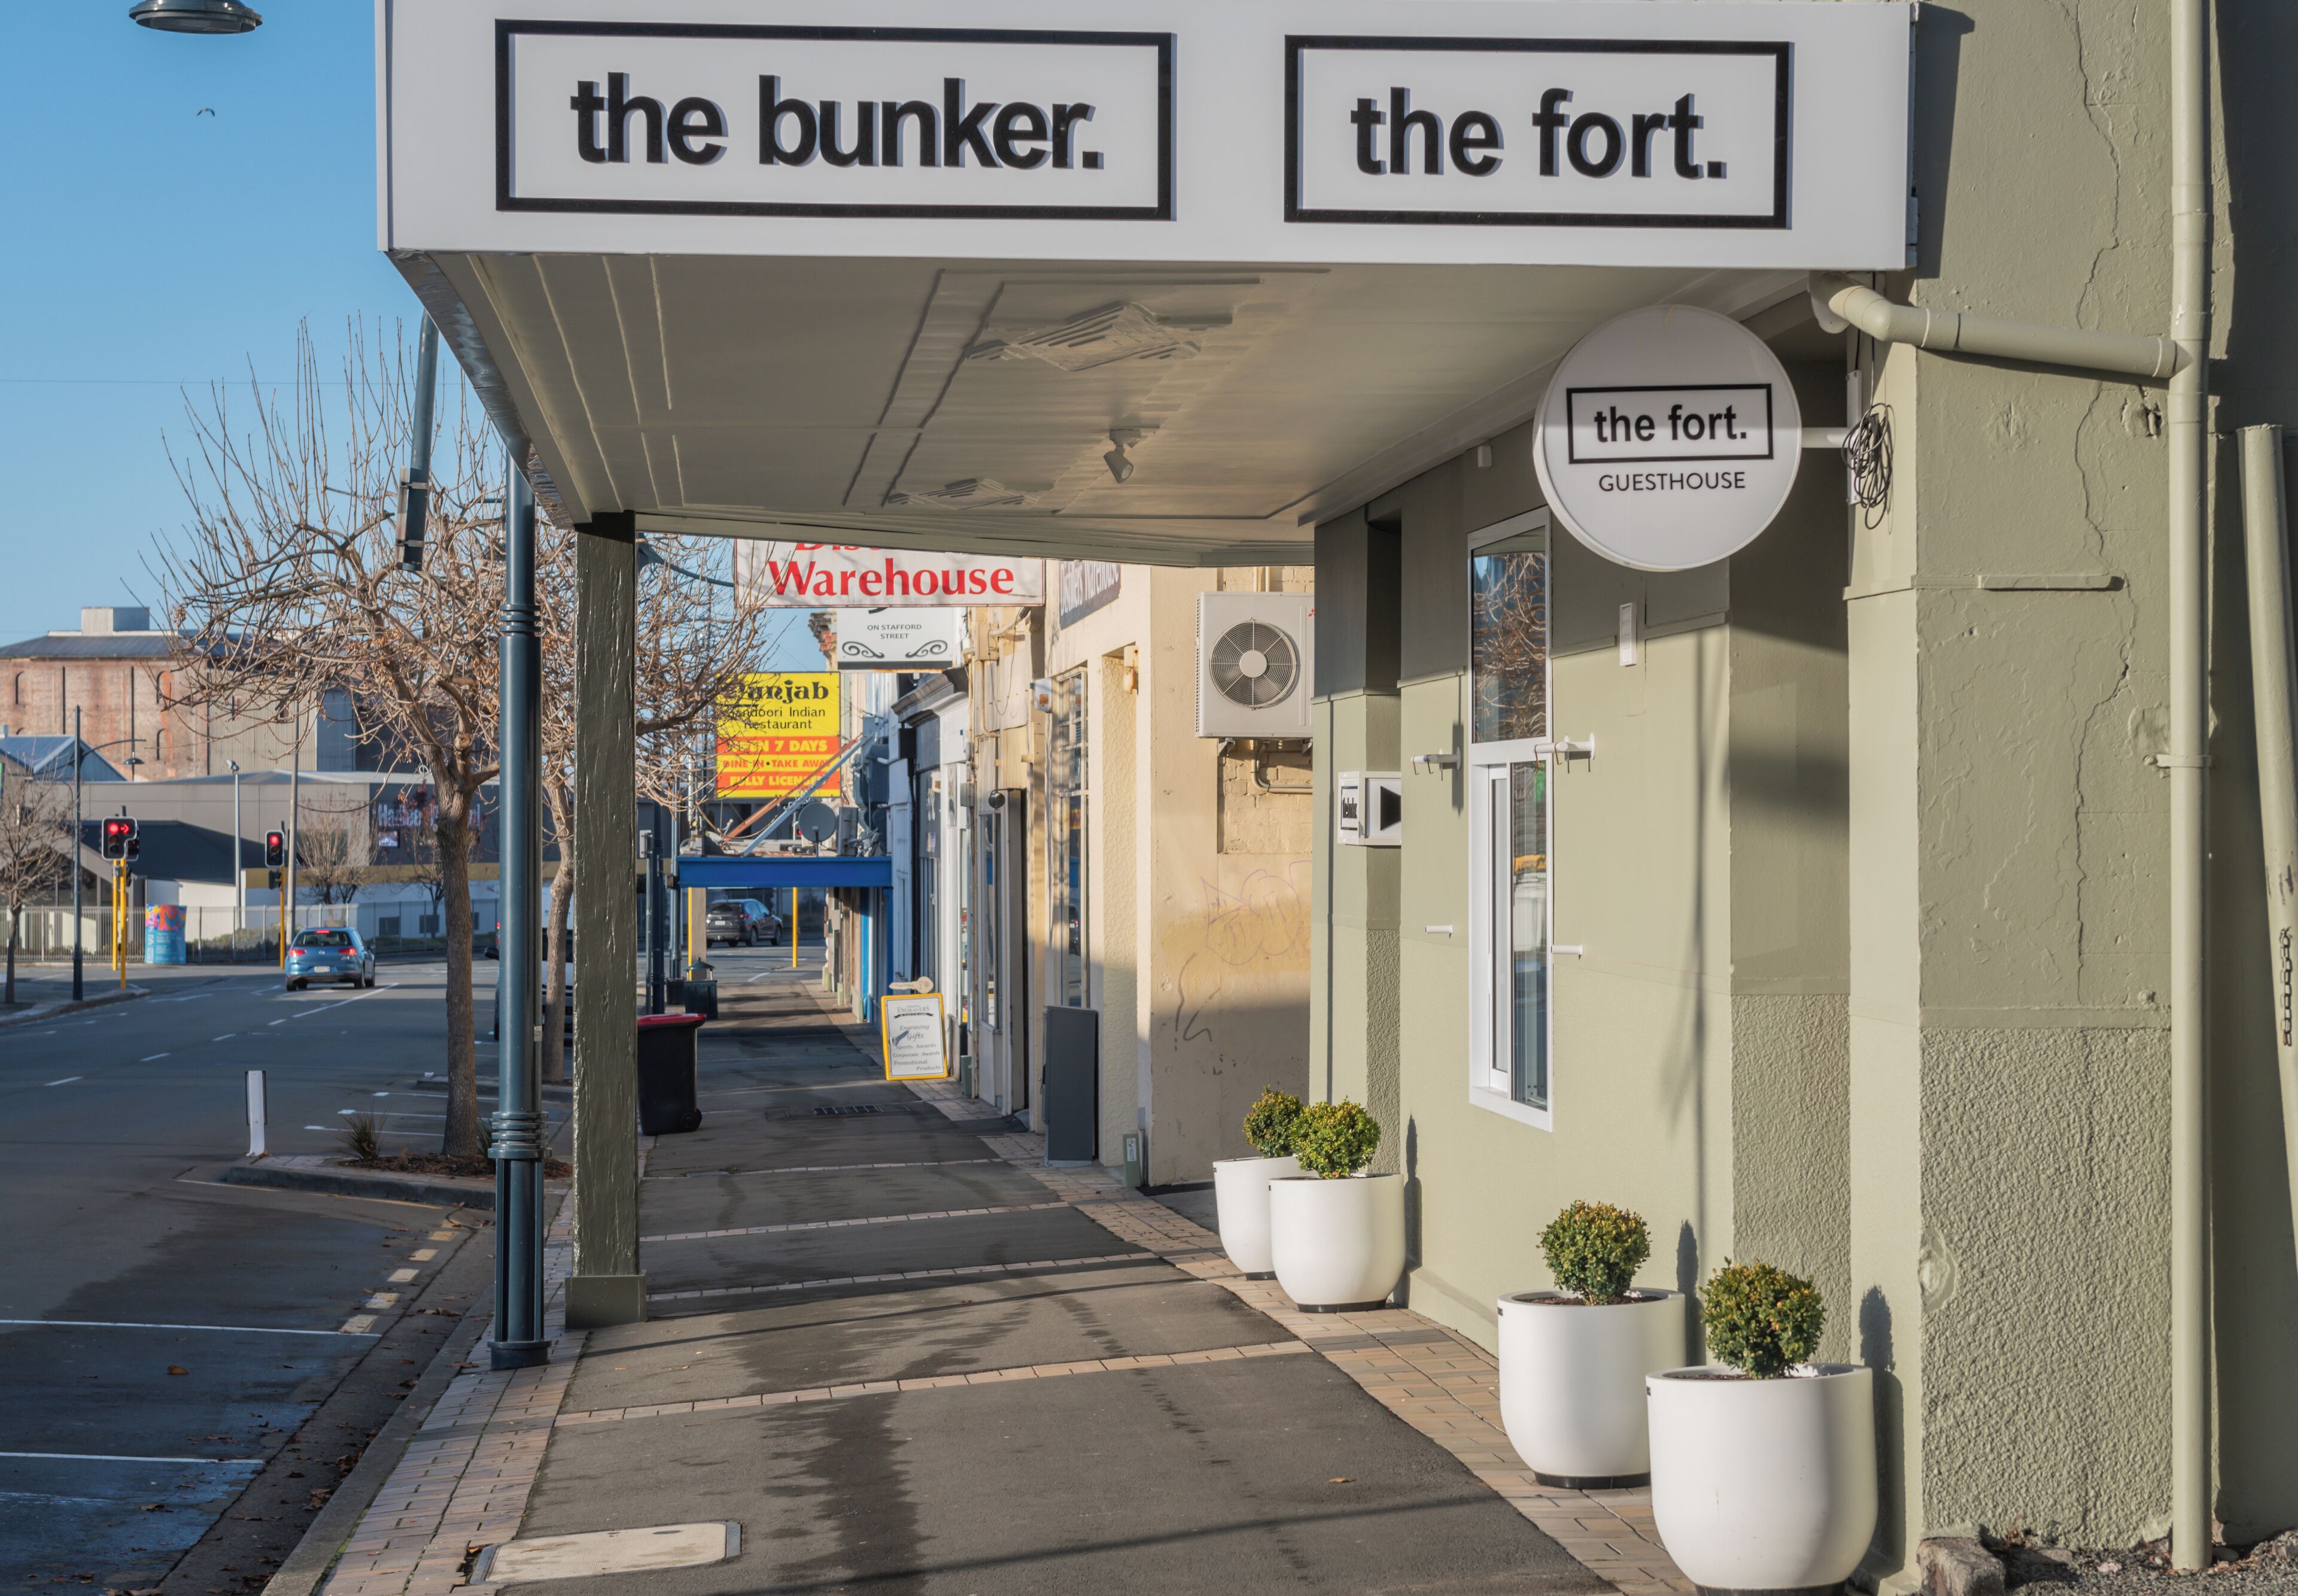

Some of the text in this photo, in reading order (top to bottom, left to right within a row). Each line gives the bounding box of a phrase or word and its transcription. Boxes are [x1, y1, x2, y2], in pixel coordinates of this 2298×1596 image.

[570, 71, 1104, 170] the bunker.
[1351, 86, 1726, 180] the fort.
[1594, 404, 1747, 443] the fort.
[1598, 472, 1746, 492] GUESTHOUSE
[767, 557, 1014, 596] Warehouse
[723, 679, 829, 704] unjab
[789, 707, 826, 717] Indian
[774, 740, 785, 752] 7
[789, 740, 828, 752] DAYS
[722, 759, 748, 768] DINE
[753, 759, 764, 768] IN
[771, 759, 798, 768] TAKE
[729, 776, 765, 786] FULLY
[906, 1032, 924, 1042] Gifts
